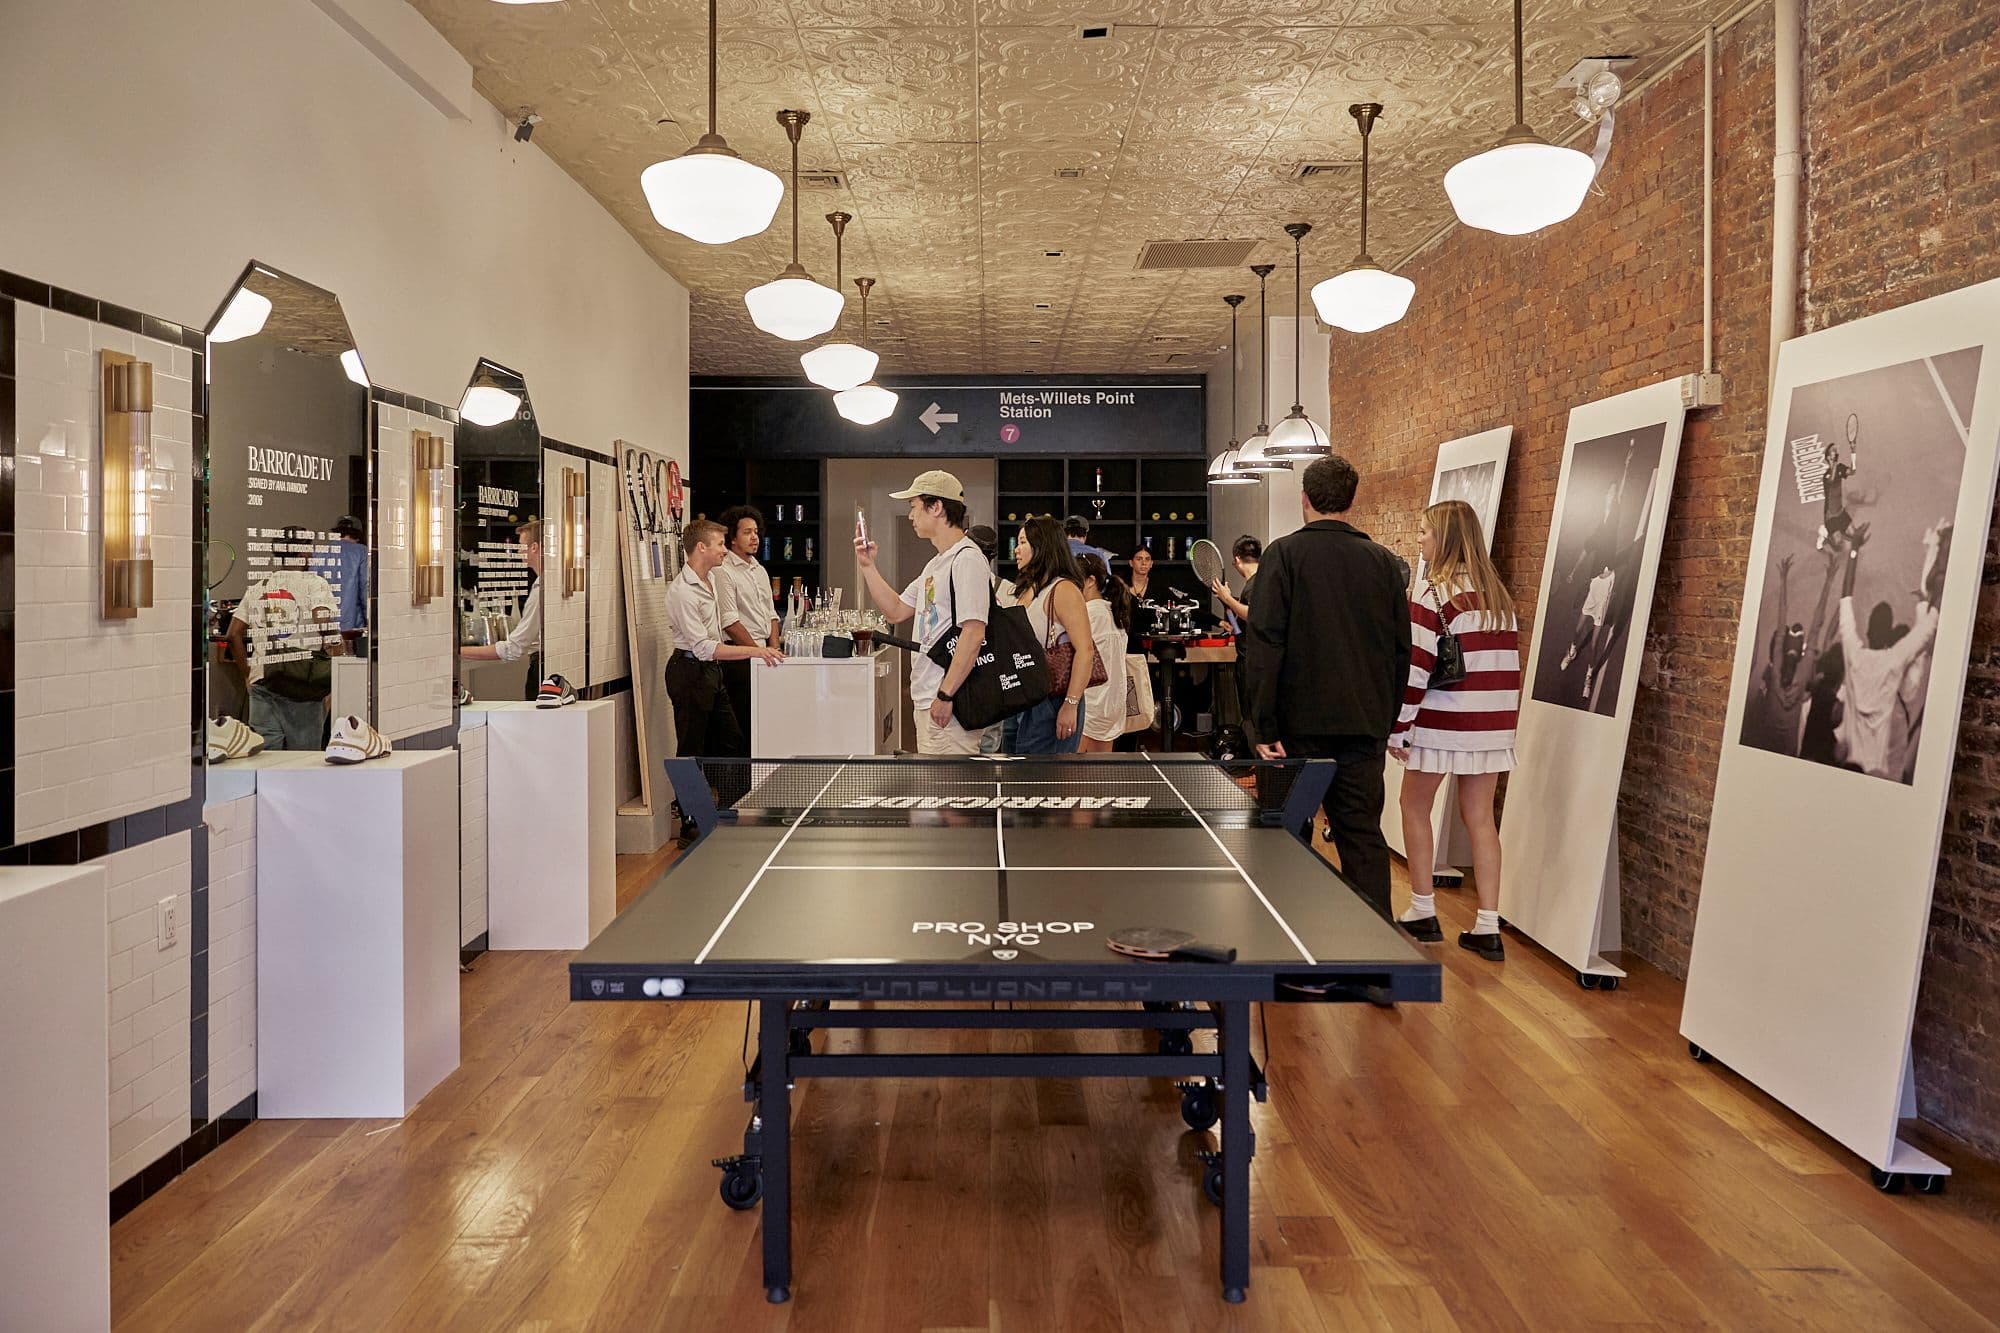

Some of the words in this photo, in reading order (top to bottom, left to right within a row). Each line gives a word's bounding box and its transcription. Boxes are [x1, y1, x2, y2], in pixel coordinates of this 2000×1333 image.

[1000, 392, 1091, 405] Mets-Willets
[1096, 391, 1135, 405] Point
[1000, 406, 1052, 418] Station
[1005, 429, 1015, 441] 7
[248, 446, 319, 480] BARRICADE
[320, 458, 333, 481] IV
[1791, 434, 1829, 504] MELBOURNE
[248, 477, 268, 489] SIGNED
[268, 480, 276, 490] BY
[276, 480, 286, 491] ANA
[247, 494, 263, 506] 2006
[478, 485, 514, 507] BARRICADE
[842, 797, 1151, 808] BARRICADE
[912, 922, 985, 934] PRO
[997, 922, 1095, 934] SHOP
[967, 933, 1041, 946] NYC
